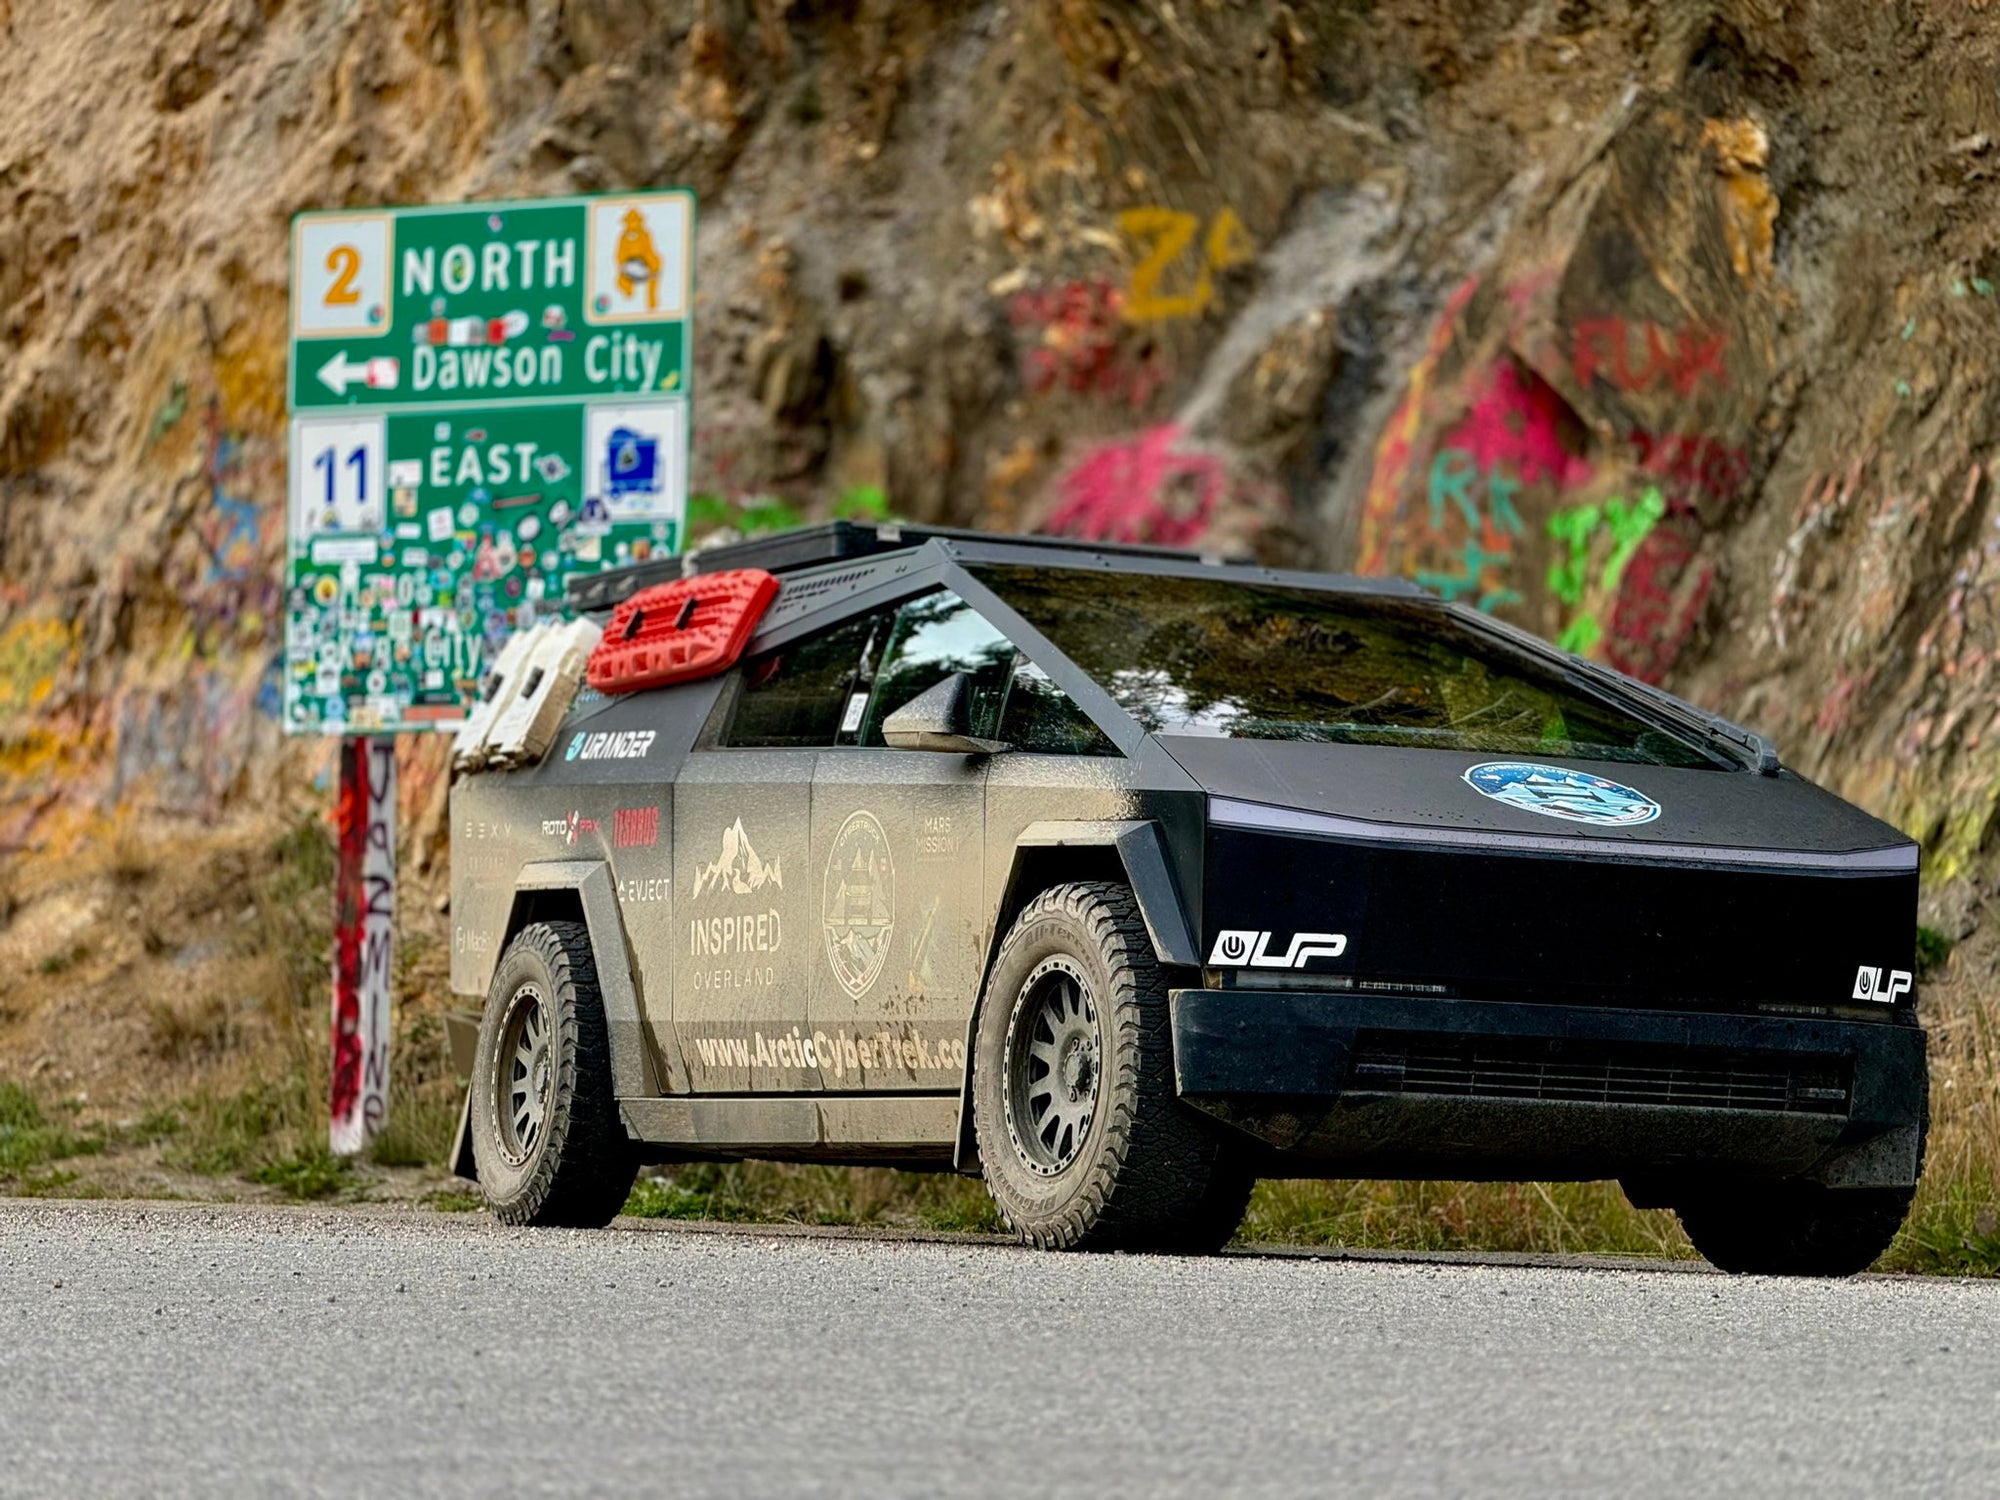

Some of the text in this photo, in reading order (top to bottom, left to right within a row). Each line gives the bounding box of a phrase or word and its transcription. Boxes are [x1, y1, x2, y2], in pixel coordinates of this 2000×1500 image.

[324, 245, 362, 306] 2
[403, 239, 575, 296] NORTH
[412, 331, 662, 393] Dawson City
[314, 445, 367, 503] 11
[430, 443, 538, 486] EAST
[924, 816, 951, 834] MARS
[690, 907, 781, 956] INSPIRED
[693, 967, 774, 990] OVERLAND
